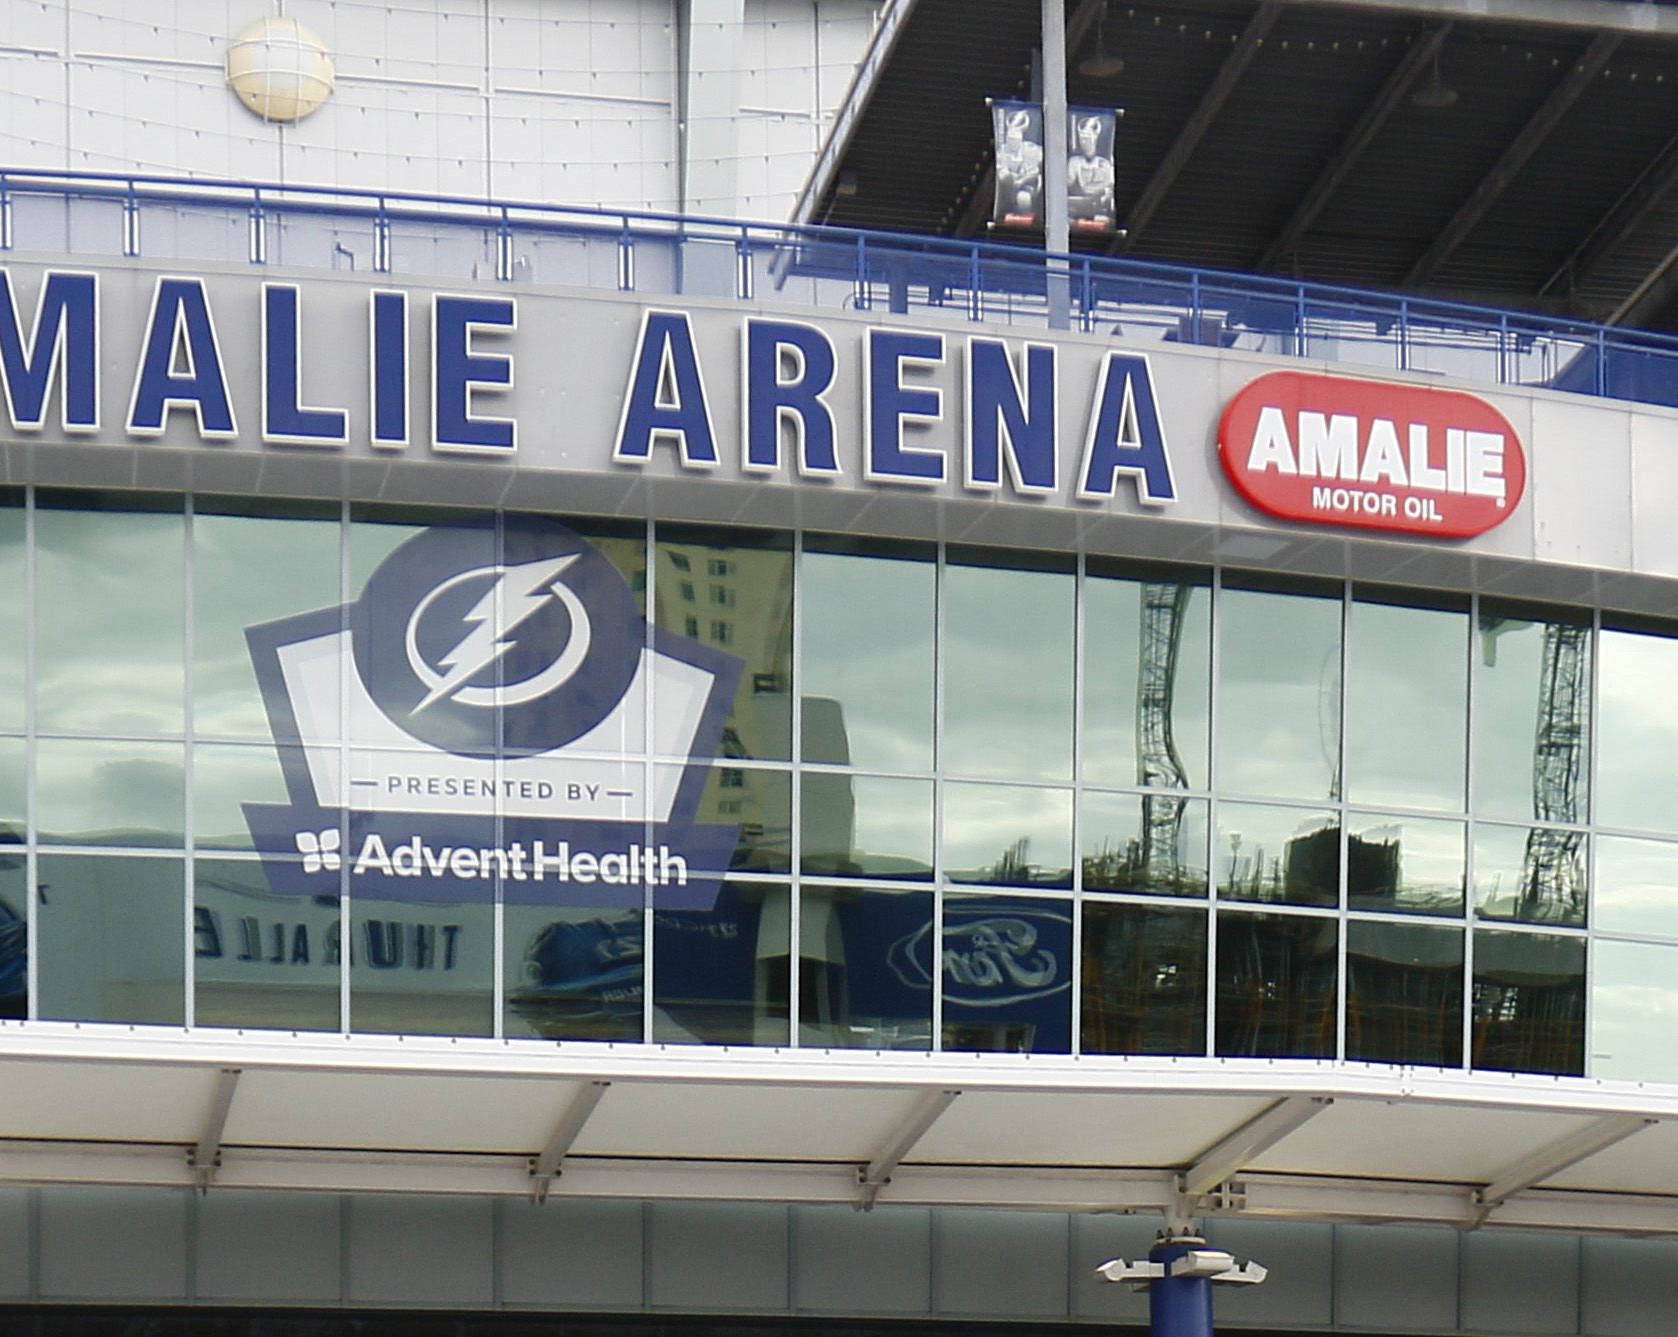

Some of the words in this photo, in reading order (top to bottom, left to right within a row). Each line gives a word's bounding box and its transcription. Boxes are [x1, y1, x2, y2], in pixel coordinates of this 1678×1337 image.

[612, 307, 1178, 508] ARENA
[1247, 405, 1506, 497] AMALIE
[1312, 486, 1397, 516] MOTOR
[1403, 496, 1443, 522] OIL
[387, 776, 554, 800] PRESENTED
[567, 782, 602, 801] BY
[352, 834, 688, 886] AdventHealth
